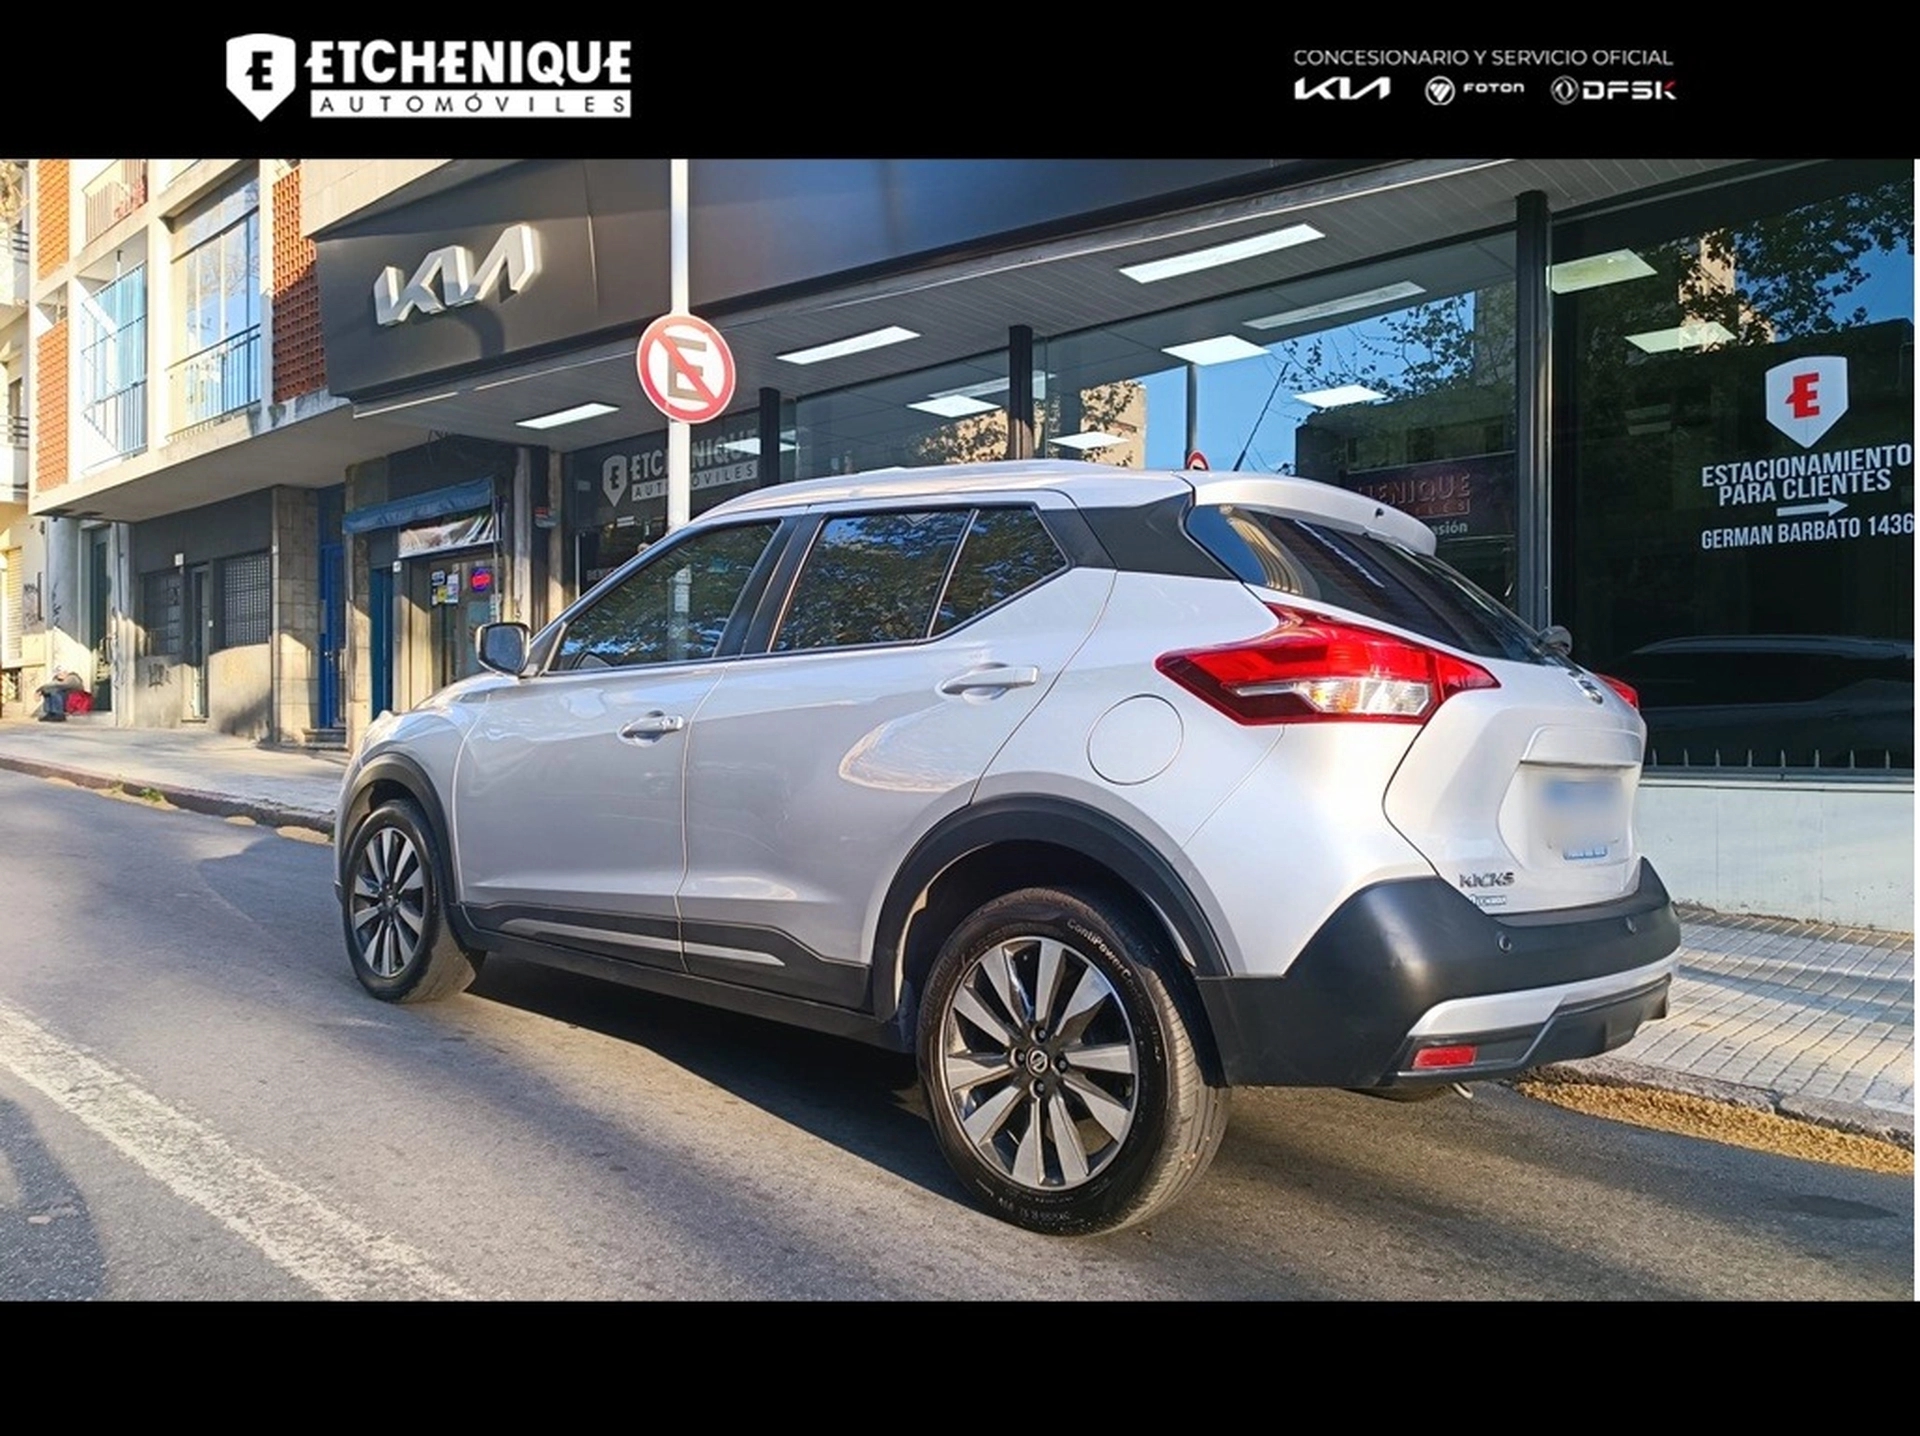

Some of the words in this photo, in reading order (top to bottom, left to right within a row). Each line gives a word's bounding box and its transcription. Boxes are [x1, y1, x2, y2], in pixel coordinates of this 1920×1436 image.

[374, 223, 539, 326] KIA
[1702, 443, 1912, 487] ESTACIONAMIENTO
[1719, 481, 1776, 507] PARA
[1783, 469, 1892, 500] CLIENTES
[1702, 524, 1773, 549] GERMAN
[1778, 517, 1861, 544] BARBATO
[1868, 513, 1914, 536] 1436
[1459, 872, 1515, 888] KICKS
